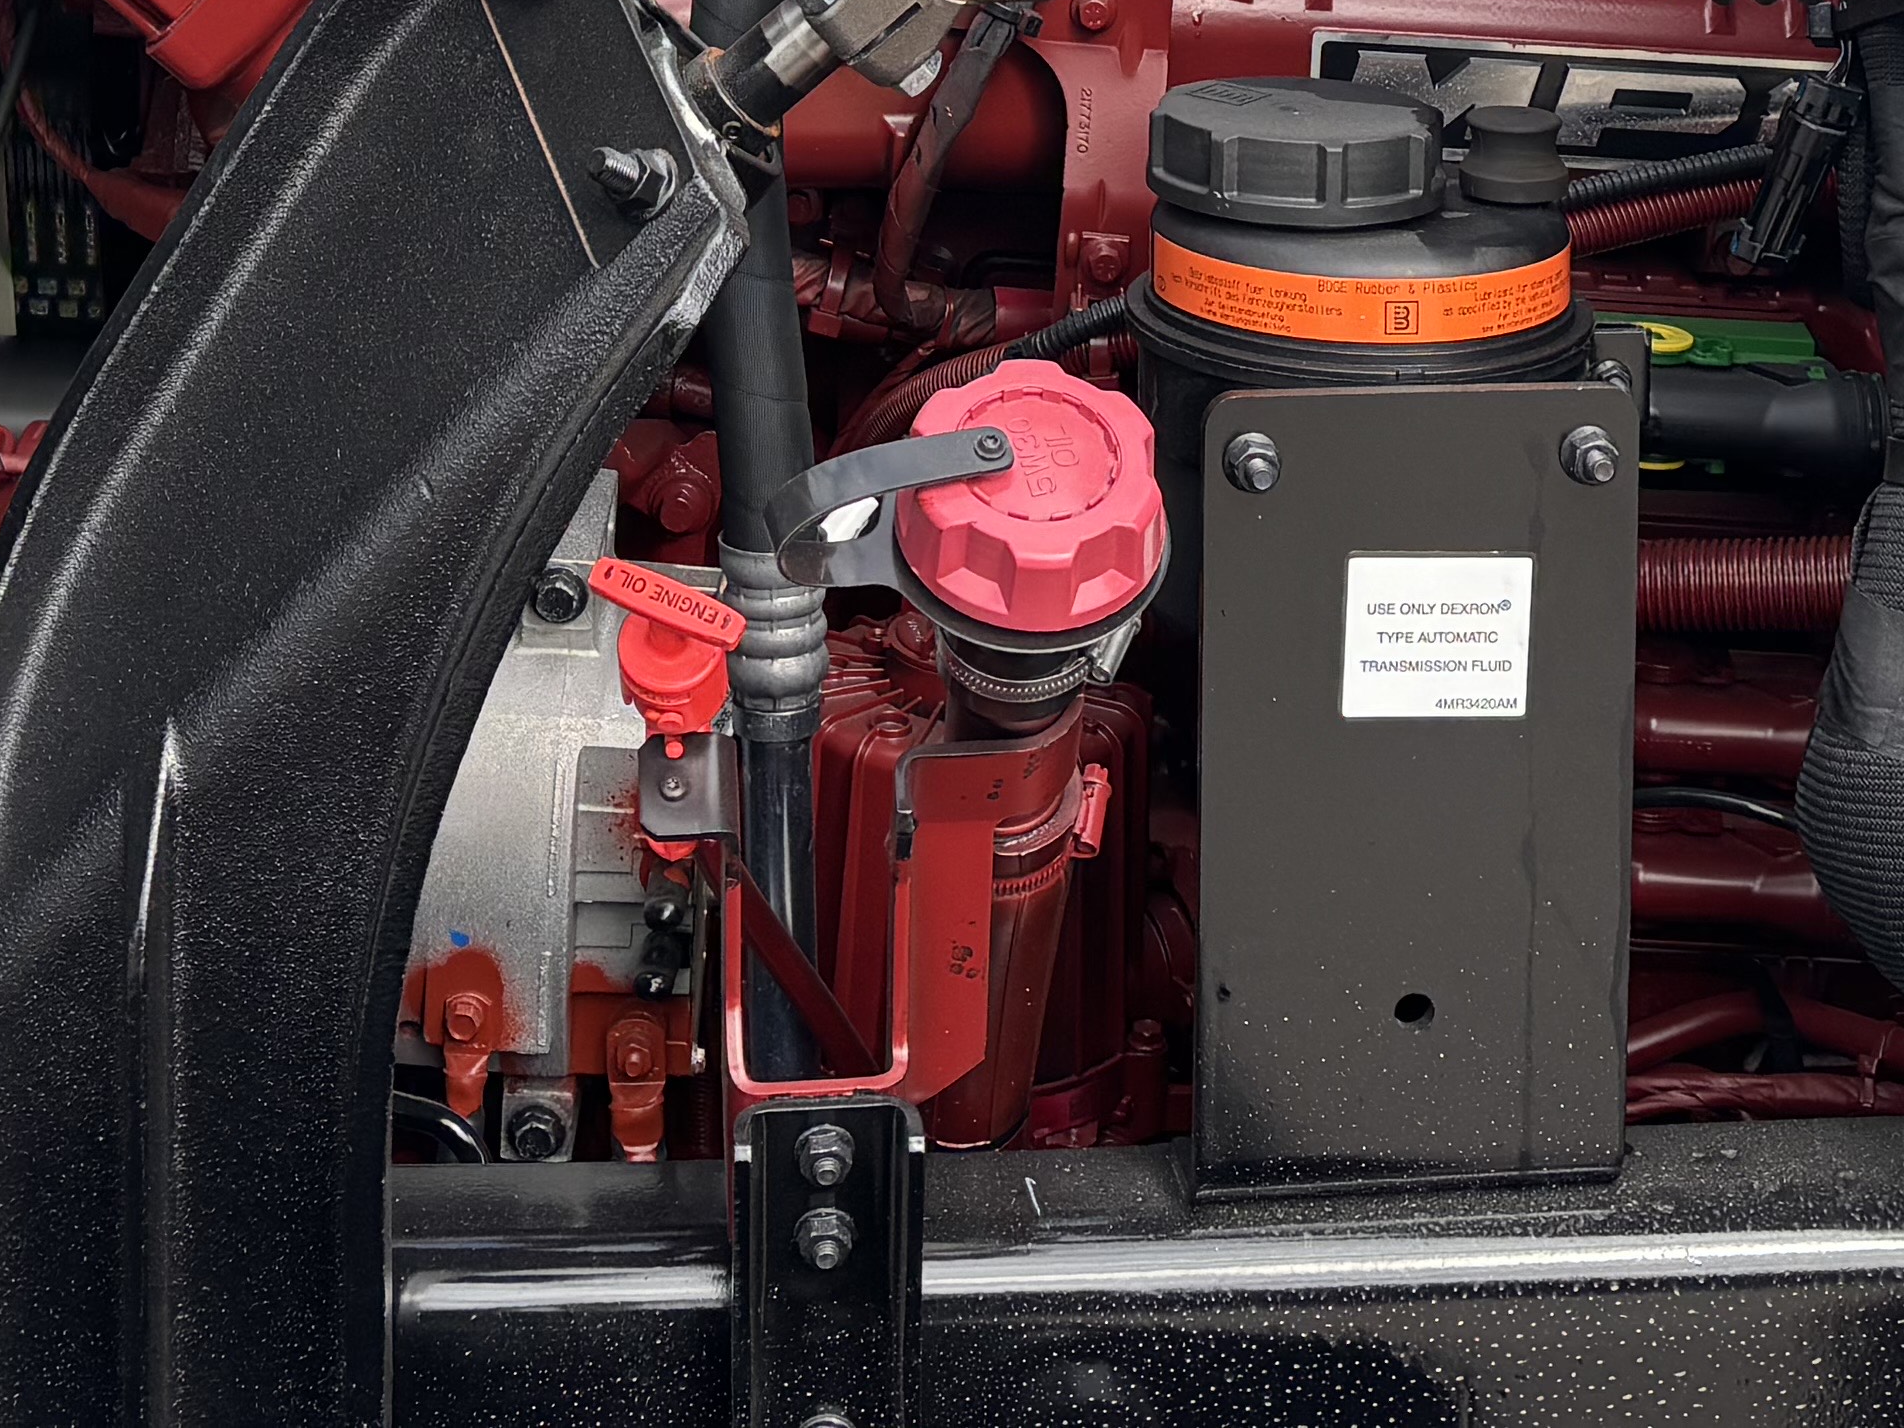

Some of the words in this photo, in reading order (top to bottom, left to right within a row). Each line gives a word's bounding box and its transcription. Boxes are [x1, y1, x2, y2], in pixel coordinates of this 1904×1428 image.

[1077, 87, 1093, 154] 21773170
[1318, 279, 1348, 293] BOGE
[1423, 281, 1478, 294] Plastics
[1044, 424, 1079, 468] OIL
[1005, 418, 1057, 498] 5W30
[619, 569, 646, 596] OIL
[648, 583, 720, 625] ENGINE
[1367, 603, 1396, 615] USE
[1400, 603, 1436, 615] ONLY
[1377, 631, 1413, 644] TYPE
[1417, 631, 1498, 644] AUTOMATIC
[1360, 660, 1468, 672] TRANSMISSION
[1472, 660, 1512, 672] FLUID
[1435, 697, 1518, 710] 4MR3420AM
